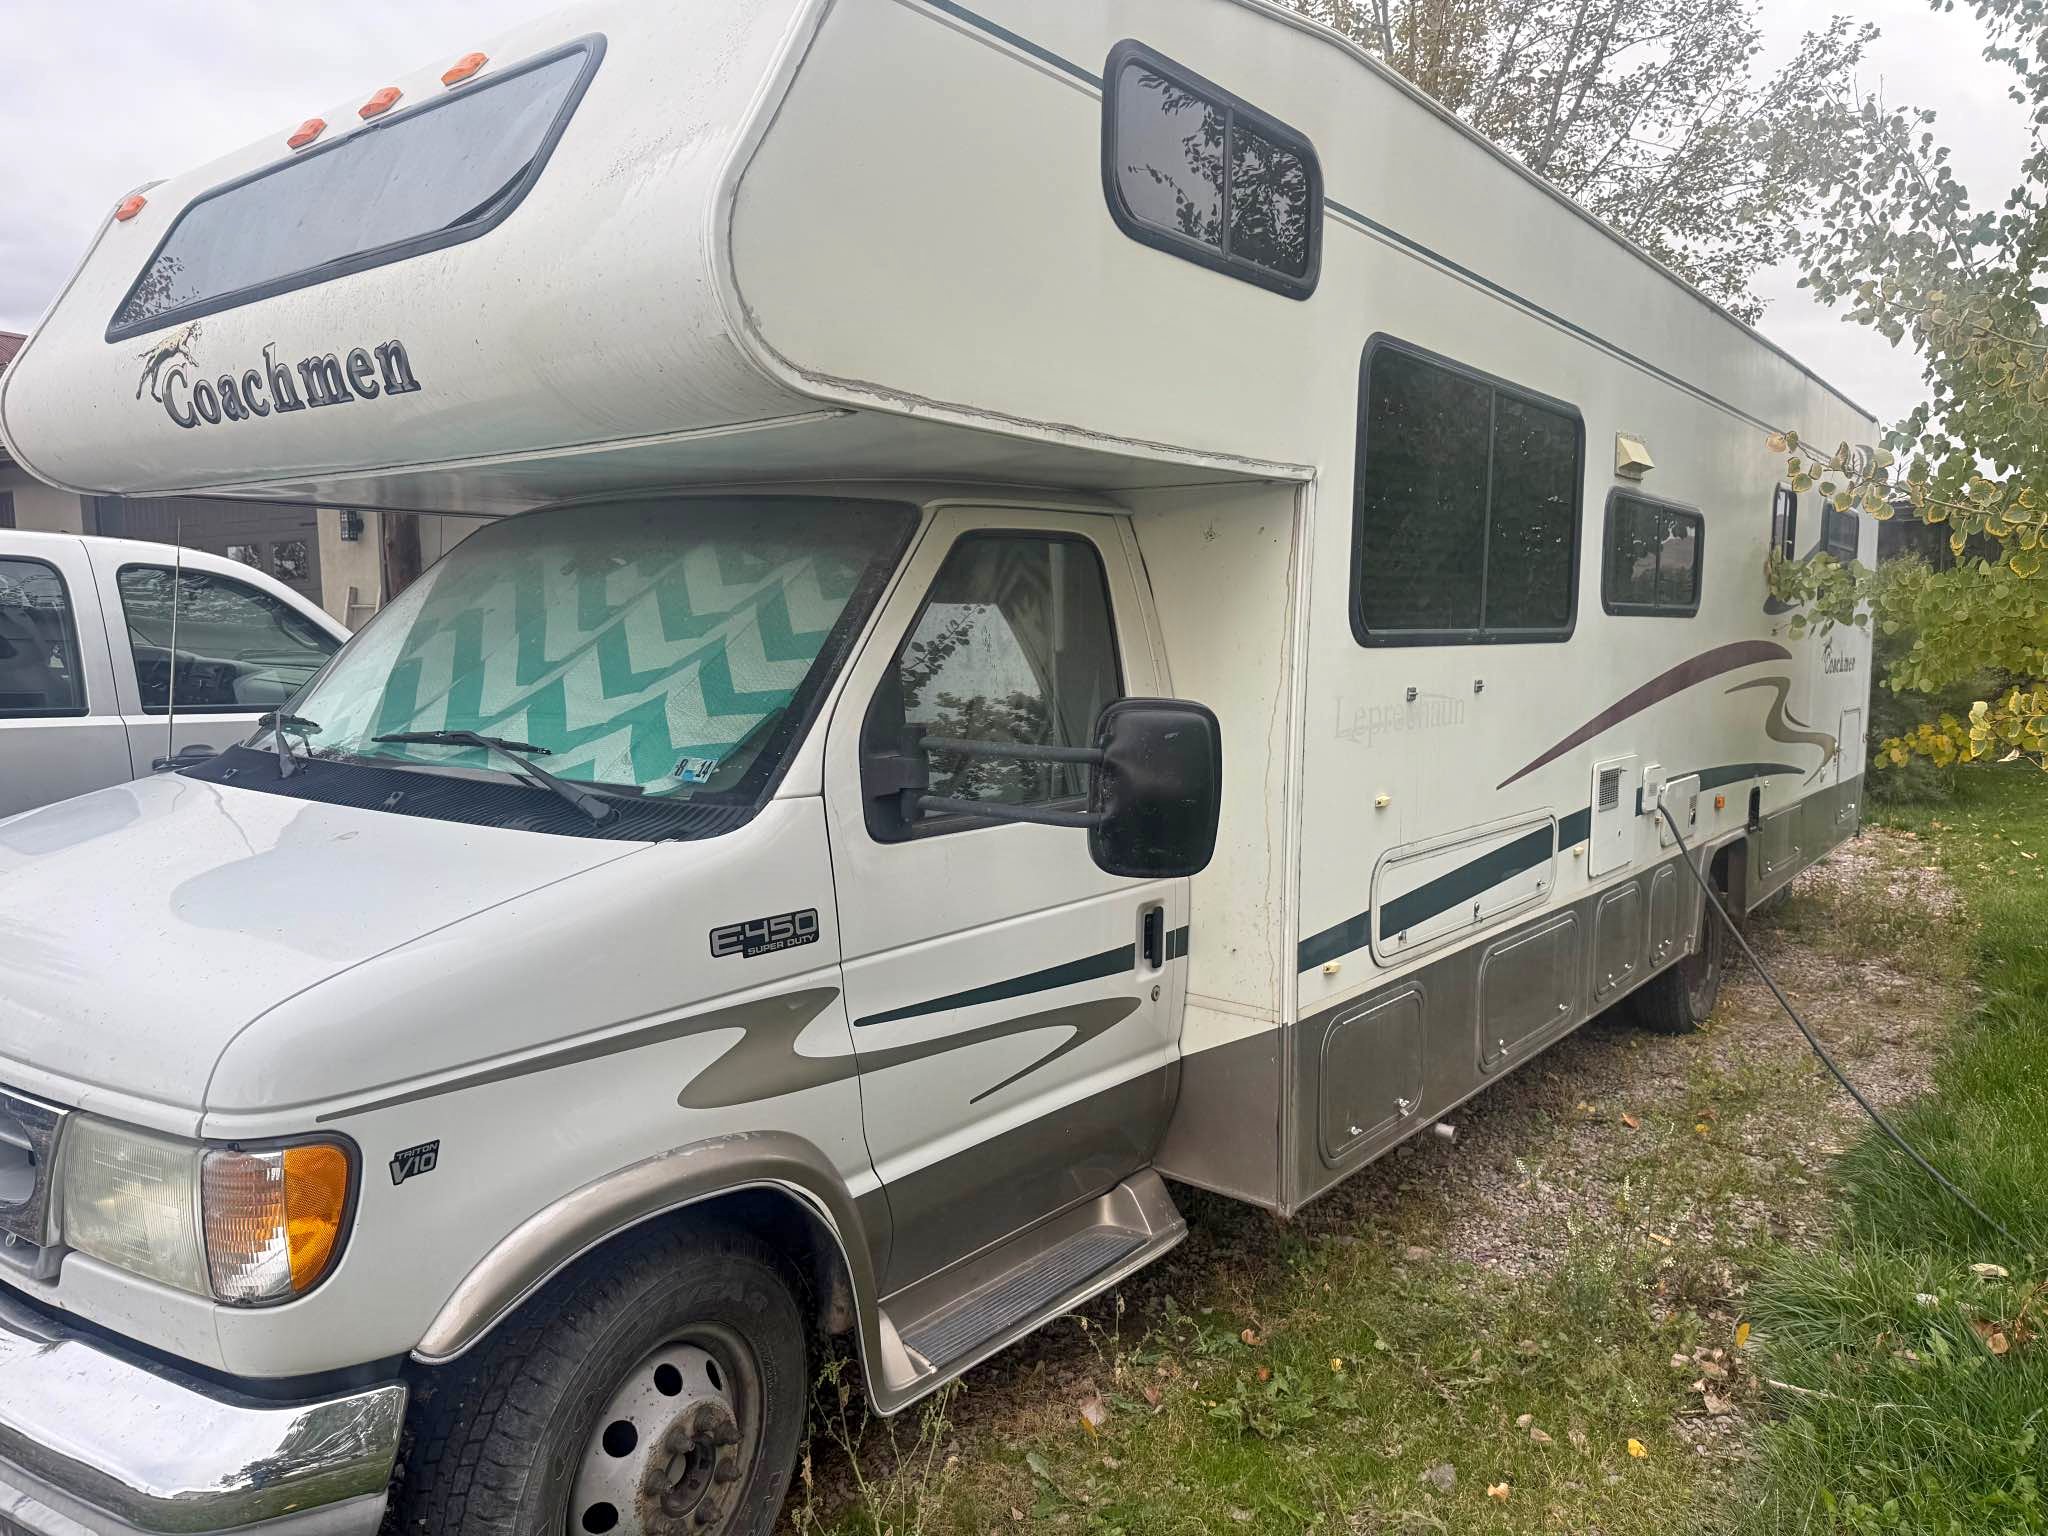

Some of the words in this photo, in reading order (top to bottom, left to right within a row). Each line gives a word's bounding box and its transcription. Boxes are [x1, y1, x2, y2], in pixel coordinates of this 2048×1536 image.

[162, 339, 422, 429] Coachmen
[747, 941, 784, 956] SUPER
[787, 933, 815, 946] DUTY
[396, 1142, 438, 1160] TRITON
[391, 1152, 436, 1184] V10
